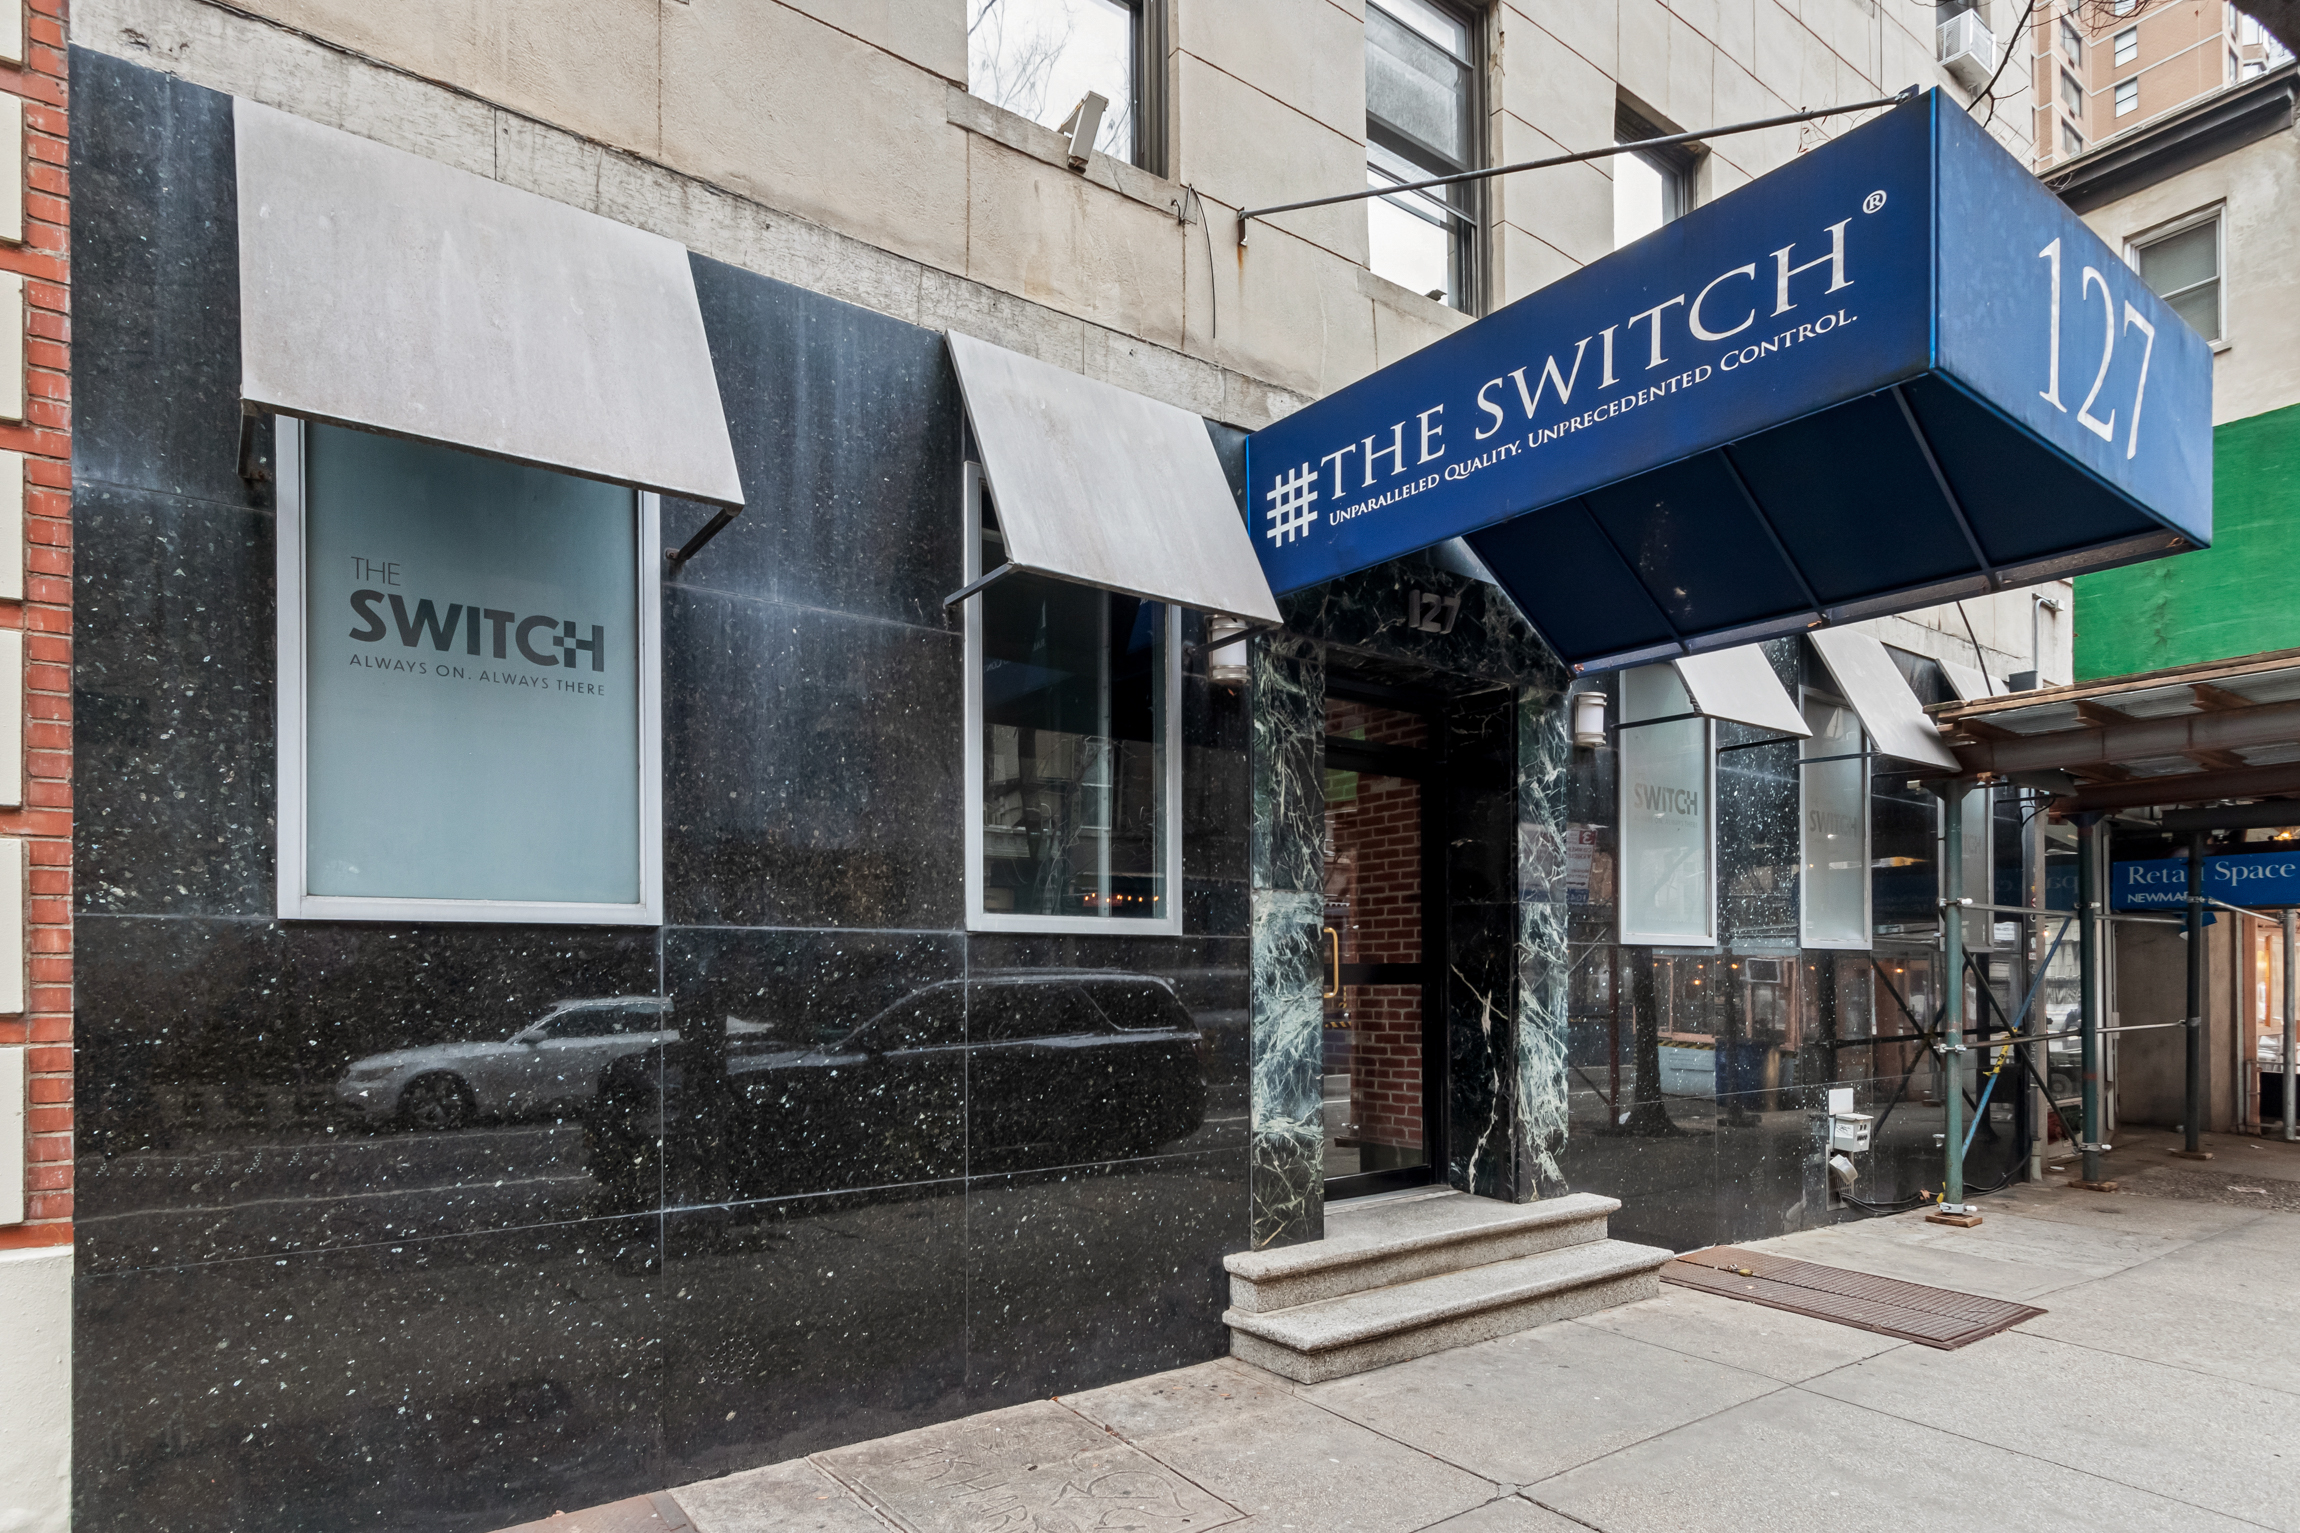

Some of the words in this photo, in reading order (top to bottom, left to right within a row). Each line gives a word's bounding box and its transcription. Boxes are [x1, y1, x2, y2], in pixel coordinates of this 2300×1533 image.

[2038, 237, 2156, 460] 127
[1329, 473, 1440, 526] UNPARALLELED
[1444, 440, 1523, 481] QUALITY.
[1527, 364, 1712, 448] UNPRECEDENTED
[1719, 308, 1859, 372] CONTROL.
[350, 556, 401, 587] THE
[348, 588, 605, 673] SWITCH
[1408, 589, 1462, 635] 127
[349, 653, 427, 675] ALWAYS
[435, 664, 472, 681] ON.
[479, 670, 549, 690] ALWAYS
[556, 679, 605, 696] THERE
[1633, 782, 1699, 816] SWITCH
[1809, 809, 1858, 838] SWITCH
[2127, 865, 2206, 885] Retal
[2214, 860, 2297, 887] Space
